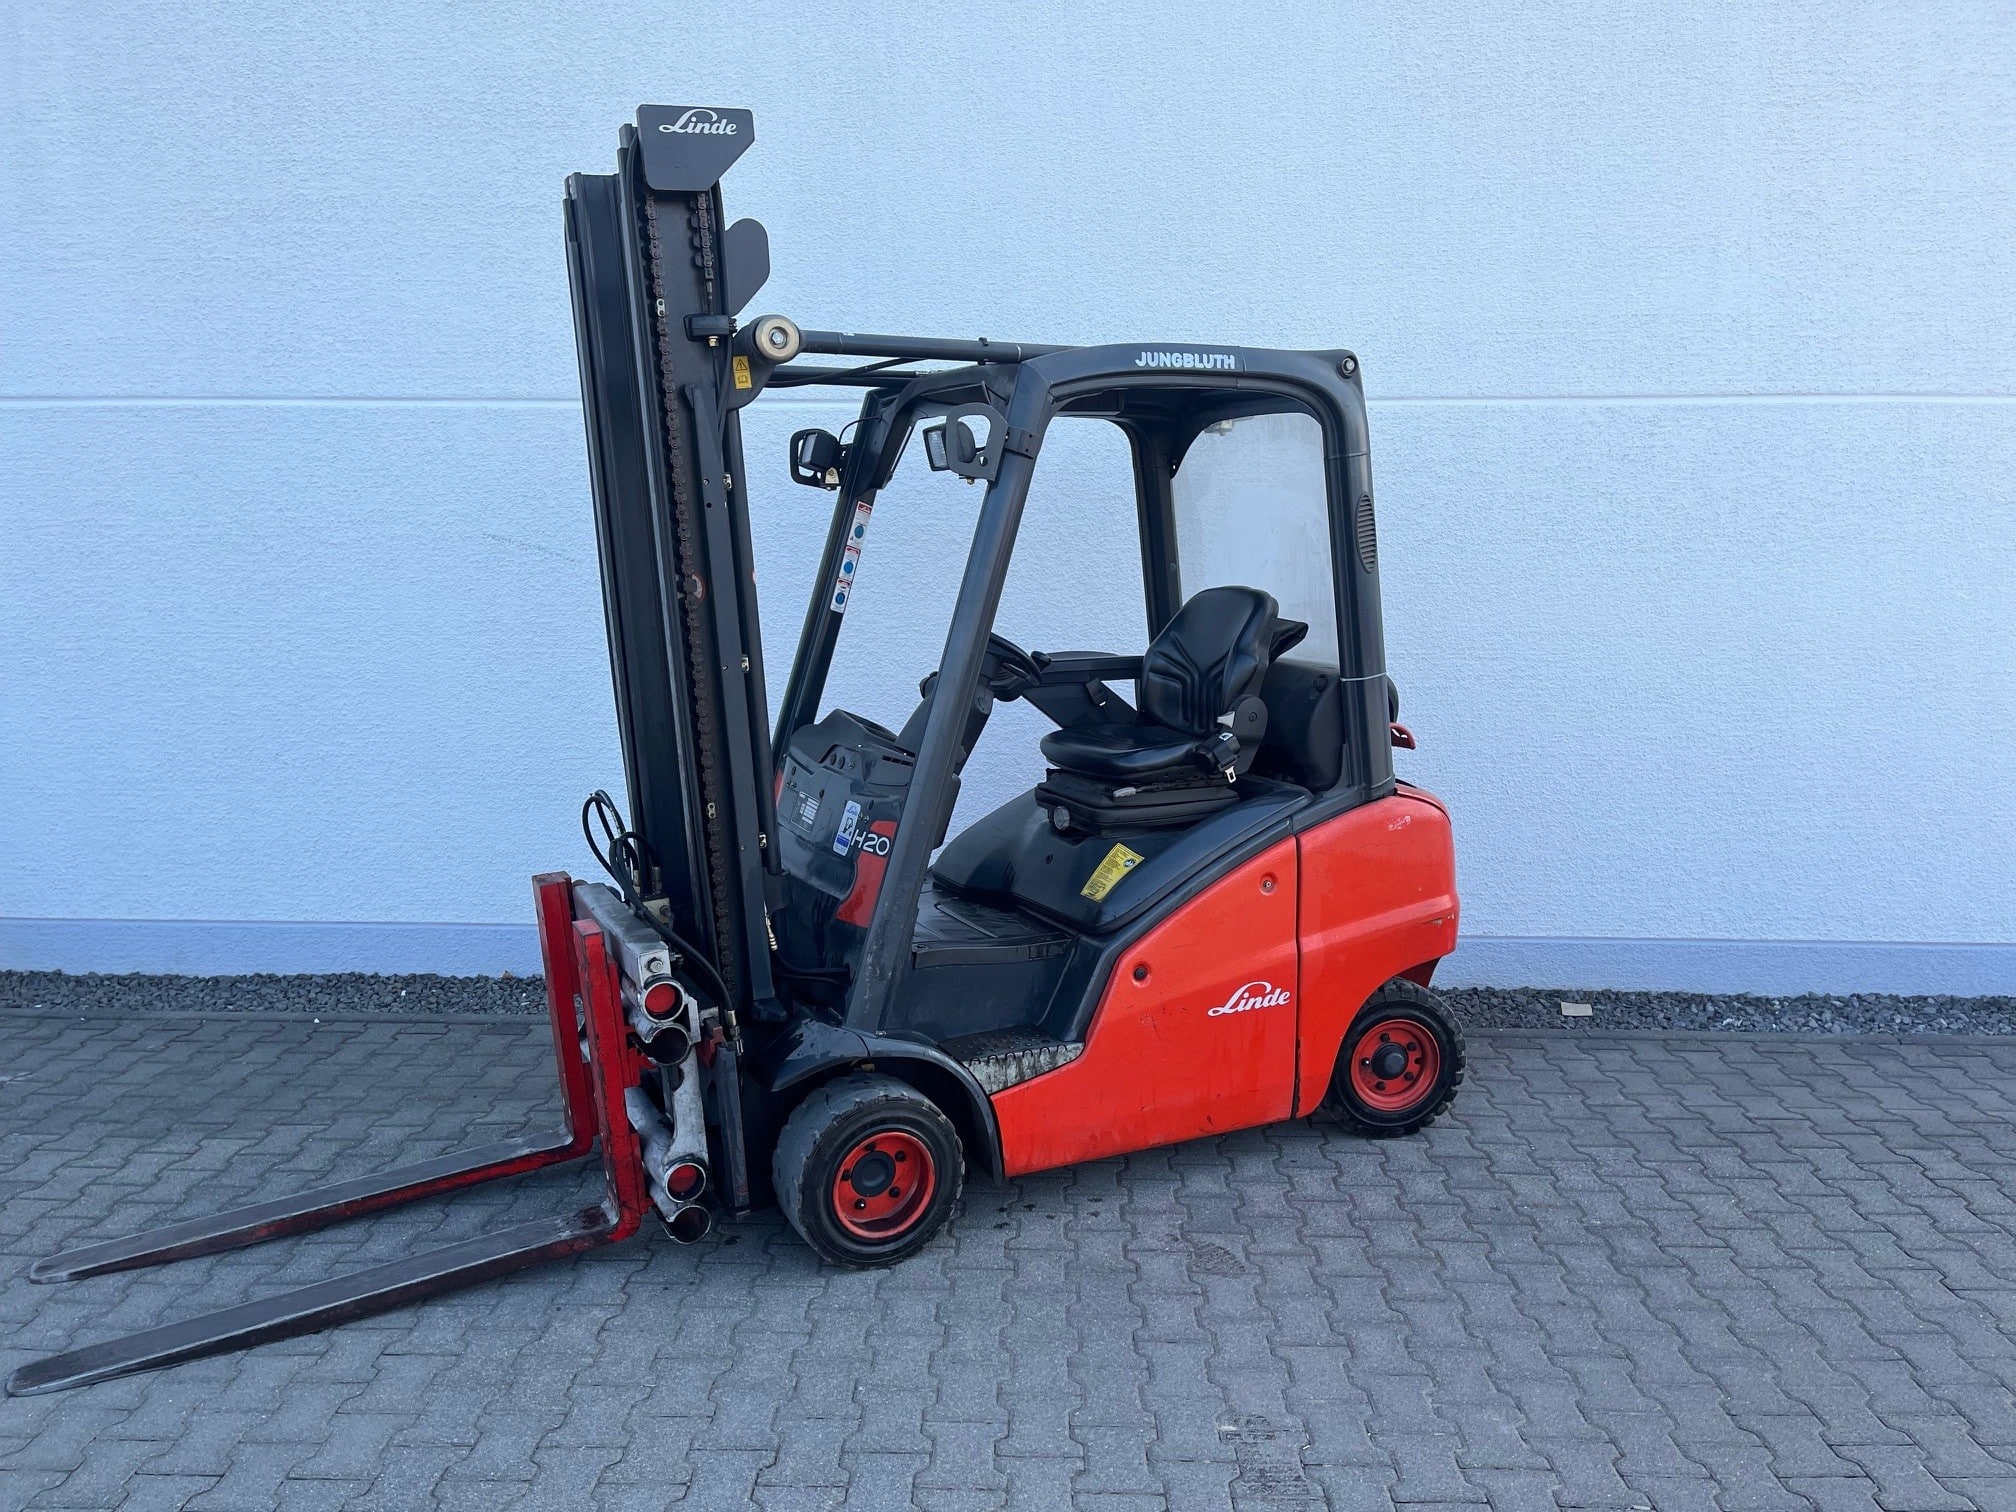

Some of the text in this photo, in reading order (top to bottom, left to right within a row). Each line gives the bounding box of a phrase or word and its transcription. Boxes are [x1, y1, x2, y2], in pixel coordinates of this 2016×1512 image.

[658, 108, 738, 135] Linde
[1134, 351, 1236, 370] JUNGBLUTH
[851, 828, 890, 856] H20
[1207, 981, 1291, 1017] Linde
